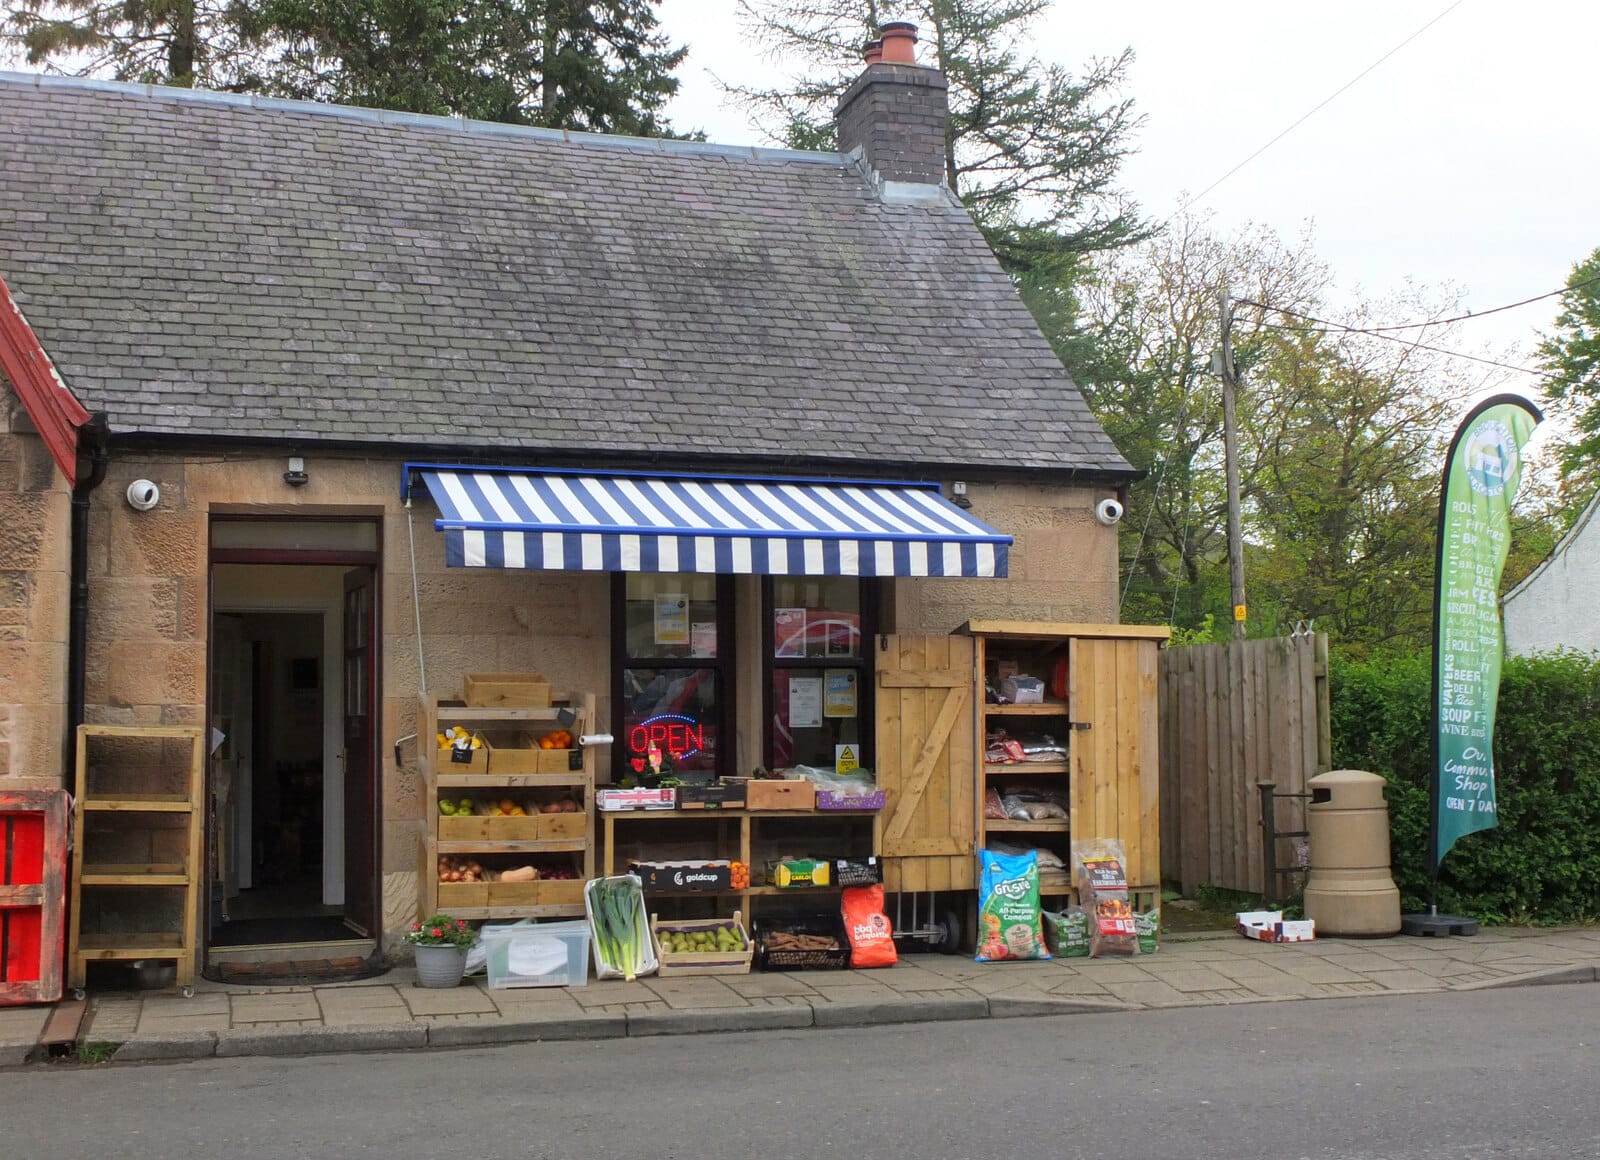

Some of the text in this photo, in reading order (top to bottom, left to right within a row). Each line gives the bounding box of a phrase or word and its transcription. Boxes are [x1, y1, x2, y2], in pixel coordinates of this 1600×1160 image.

[1441, 707, 1472, 724] SOUP
[630, 724, 704, 753] OPEN
[1455, 775, 1487, 798] Shop
[1446, 796, 1465, 812] OPEN
[1467, 799, 1475, 812] 7
[686, 872, 718, 884] goldcup
